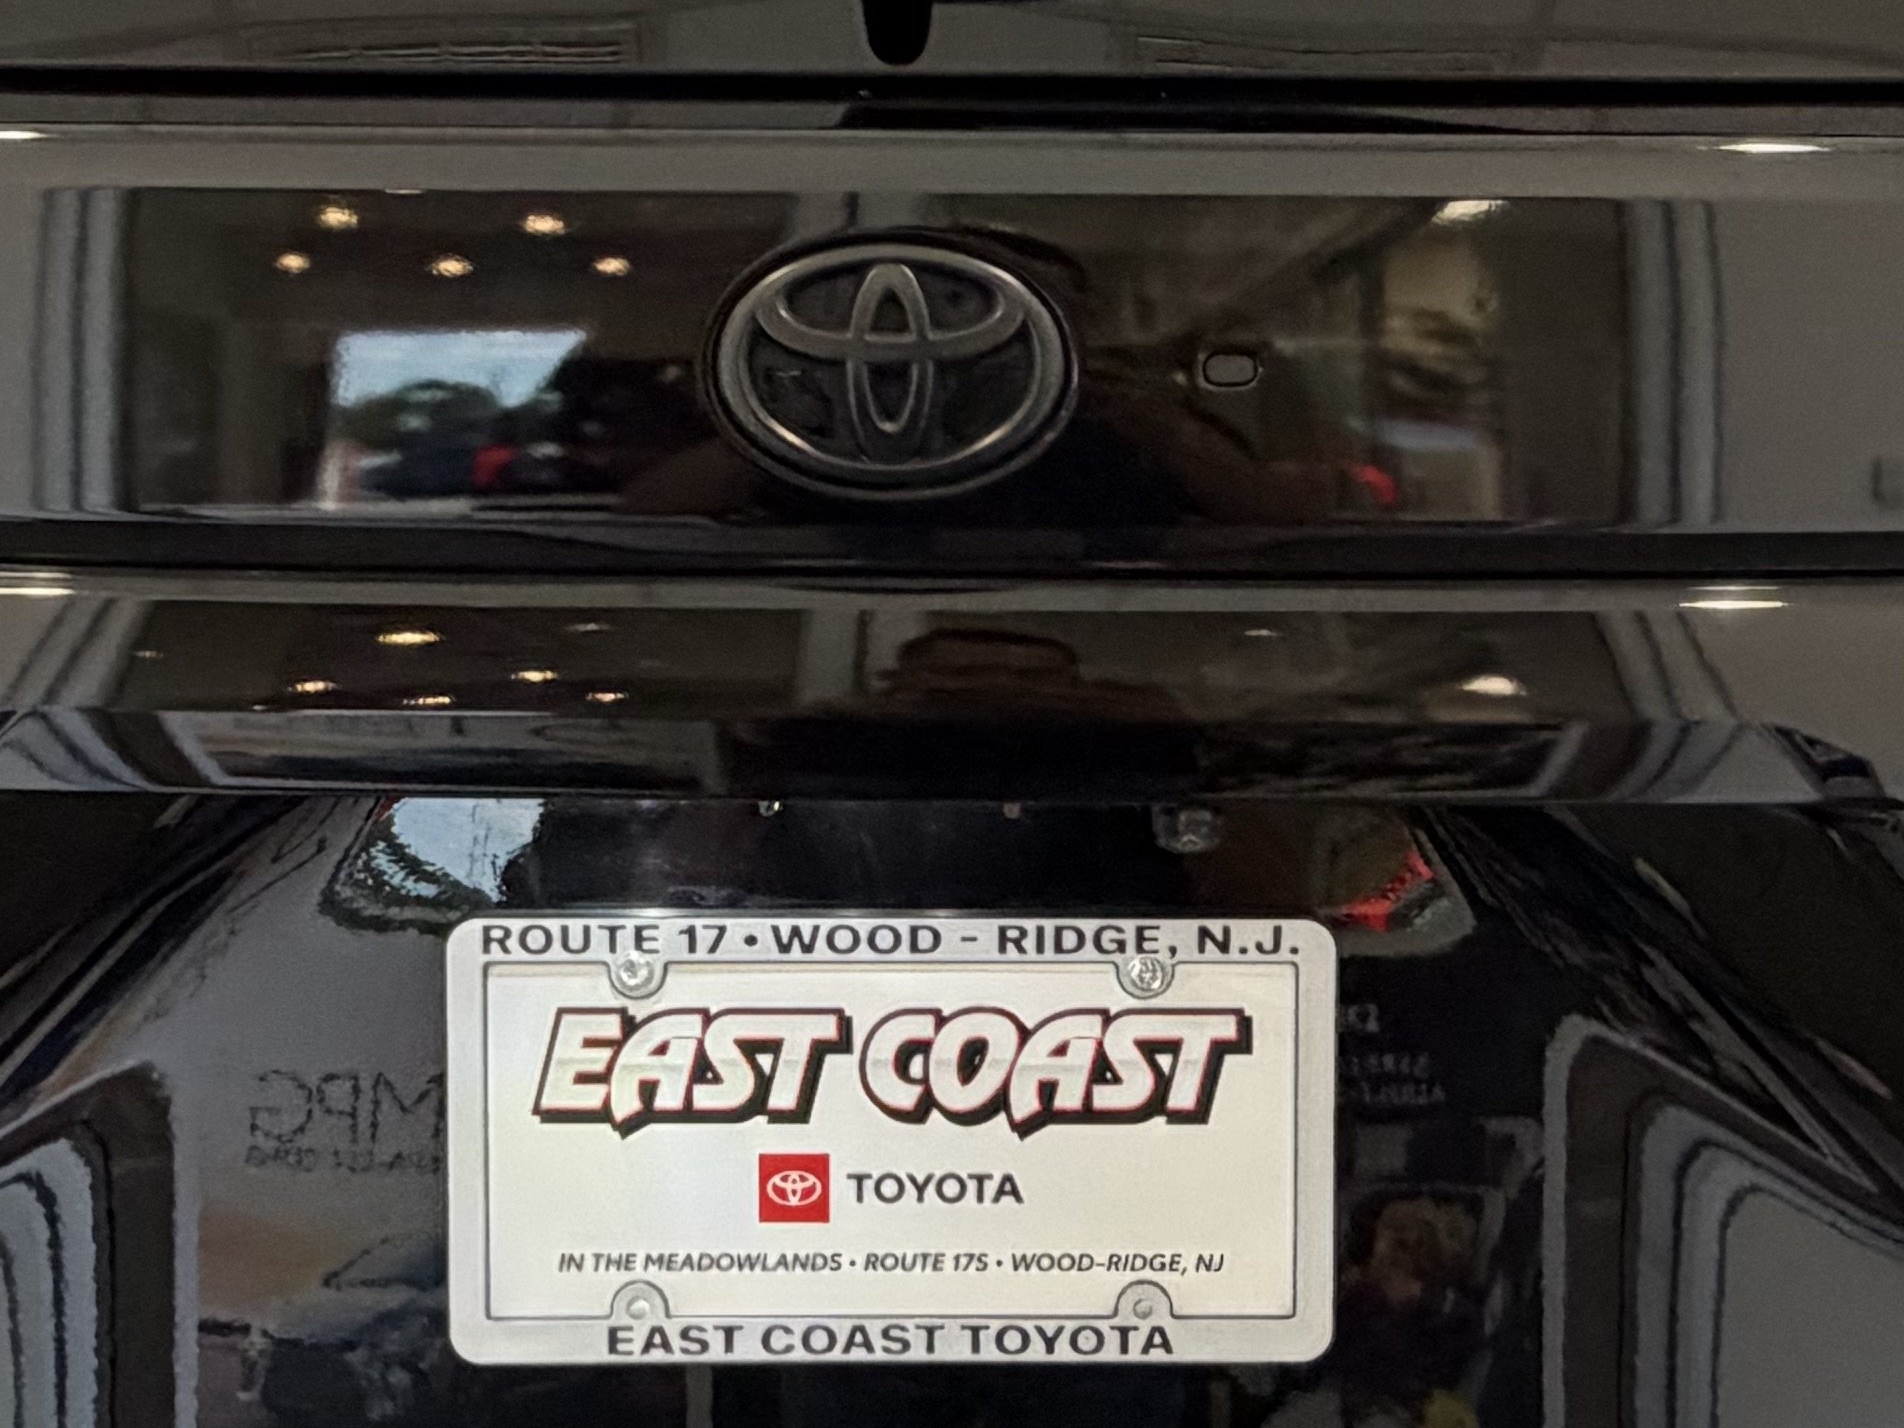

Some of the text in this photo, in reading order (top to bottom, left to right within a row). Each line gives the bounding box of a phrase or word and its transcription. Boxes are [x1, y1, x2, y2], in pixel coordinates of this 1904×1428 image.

[482, 924, 661, 955] ROUTE
[678, 924, 728, 955] 17
[770, 924, 942, 955] WOOD
[997, 924, 1178, 959] RIDGE,
[1197, 924, 1300, 955] N.J.
[532, 1005, 1253, 1141] EAST COAST
[846, 1172, 1024, 1204] TOYOTA
[558, 1253, 1225, 1276] IN THE MEADOWLANDS ROUTE 17S WOOD-RIDGE, NJ
[607, 1324, 1173, 1356] EAST COAST TOYOTA
